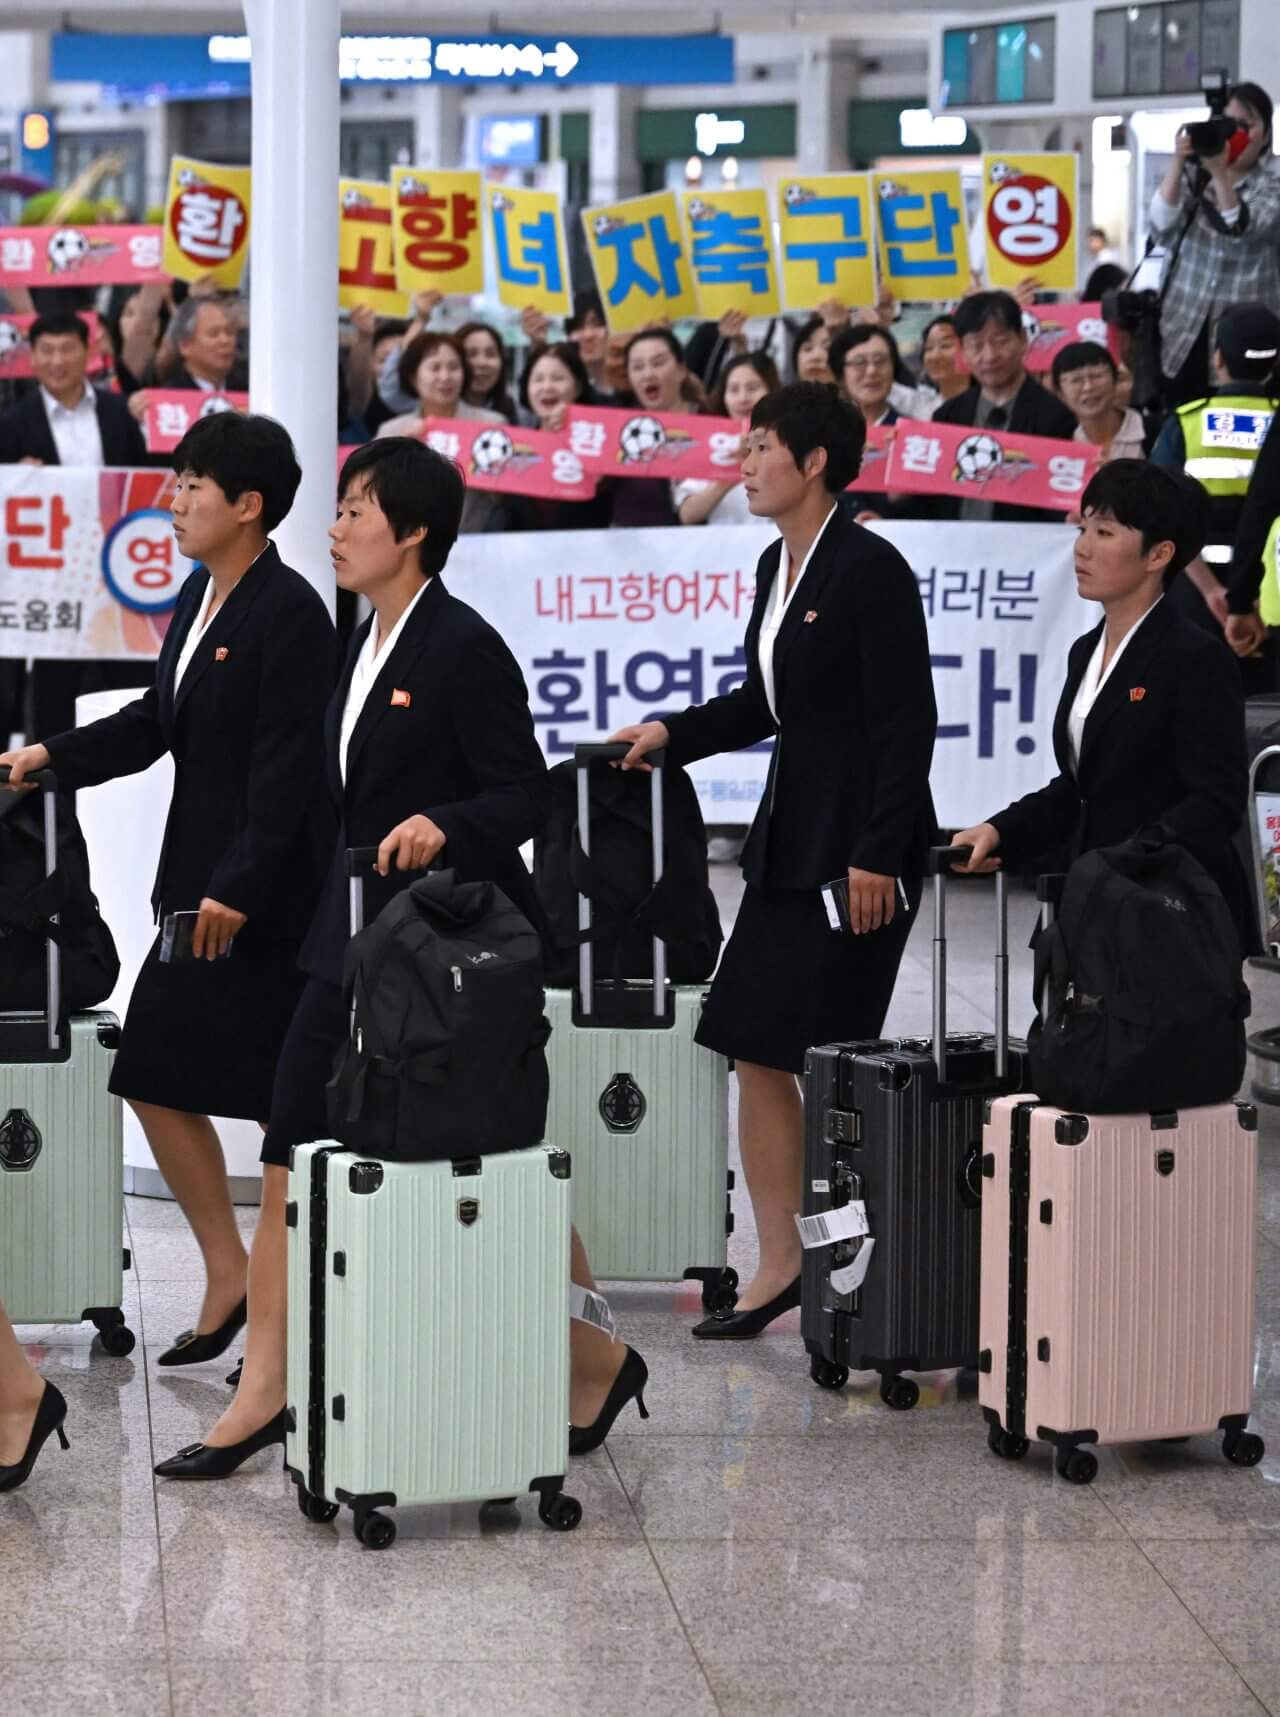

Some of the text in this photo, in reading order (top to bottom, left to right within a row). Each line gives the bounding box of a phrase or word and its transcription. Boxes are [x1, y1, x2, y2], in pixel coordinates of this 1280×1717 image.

[176, 192, 245, 259] 환
[398, 190, 477, 273] 향
[491, 208, 563, 293] 녀
[595, 214, 682, 306] 자
[692, 211, 770, 294] 축
[786, 195, 868, 285] 구
[877, 191, 960, 278] 단
[993, 185, 1060, 257] 영
[126, 536, 173, 589] 영
[534, 568, 757, 624] 내고향여자
